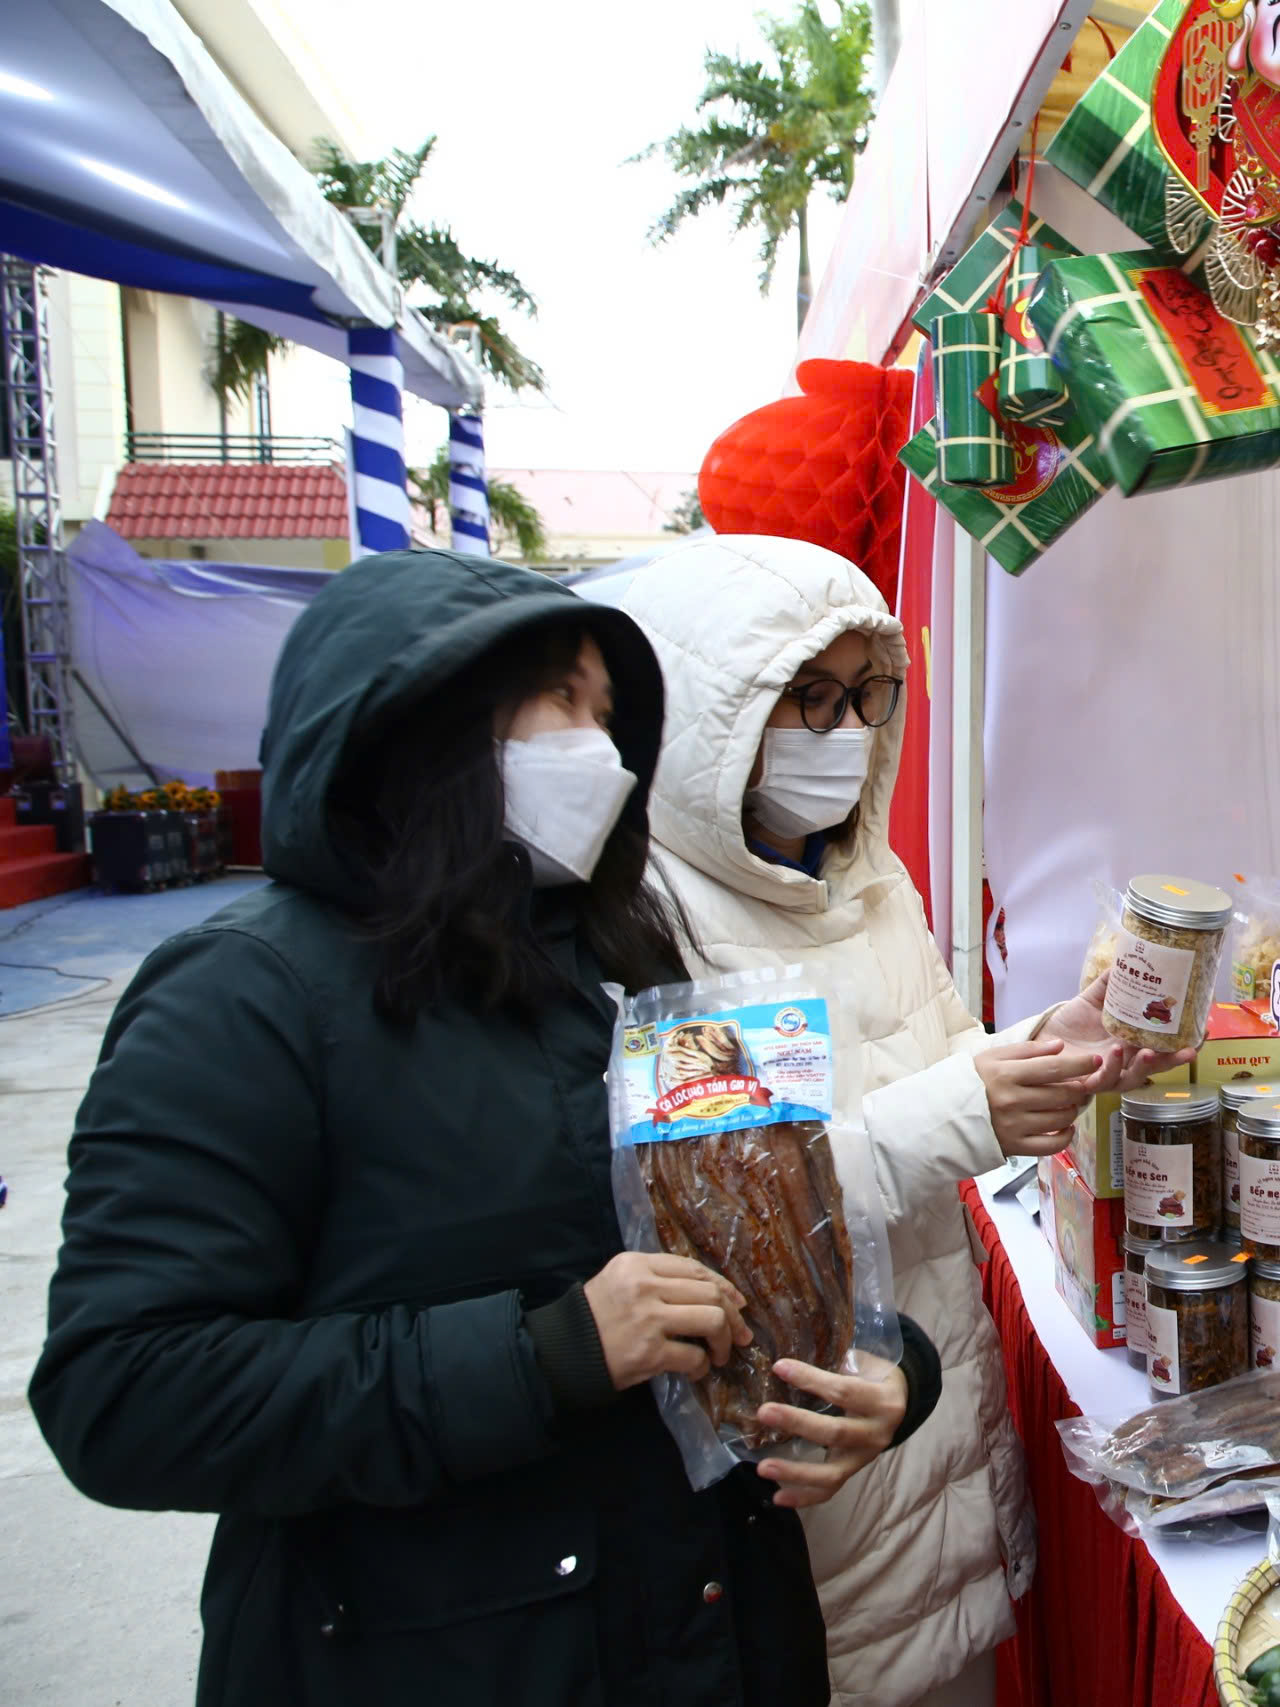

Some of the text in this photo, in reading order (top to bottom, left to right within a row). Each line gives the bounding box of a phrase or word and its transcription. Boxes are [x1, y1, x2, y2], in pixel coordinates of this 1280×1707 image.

[1142, 972, 1162, 985] Sen
[1217, 1056, 1271, 1067] BÁNH QUY
[730, 1080, 745, 1091] GIA
[1150, 1172, 1168, 1182] Sen
[1250, 1185, 1264, 1198] Bếp
